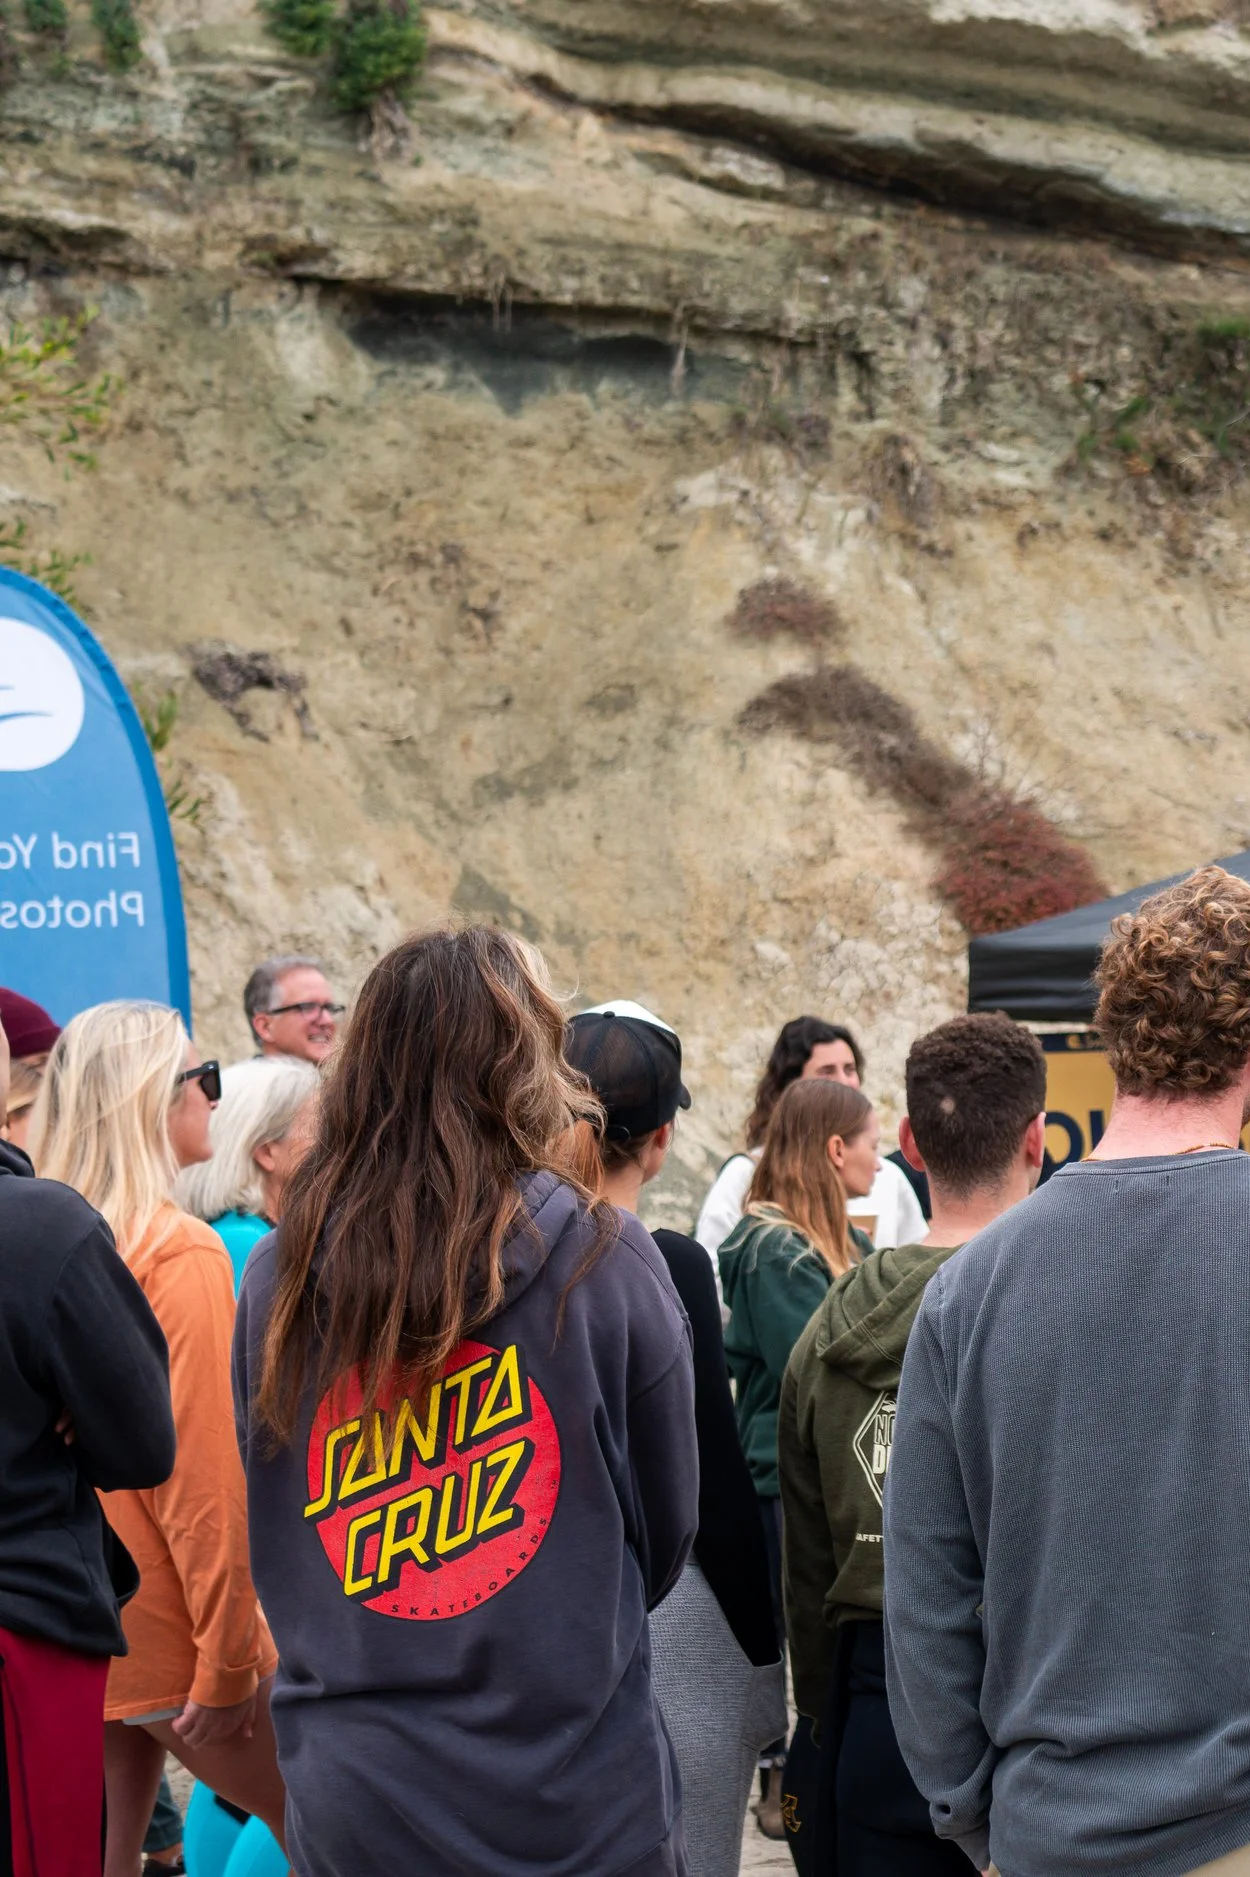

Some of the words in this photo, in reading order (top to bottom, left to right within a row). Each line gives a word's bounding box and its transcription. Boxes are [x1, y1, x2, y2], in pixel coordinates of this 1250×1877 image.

[303, 1344, 523, 1519] SANTA
[343, 1440, 526, 1597] CRUZ
[391, 1517, 548, 1617] SKATEBOARDS
